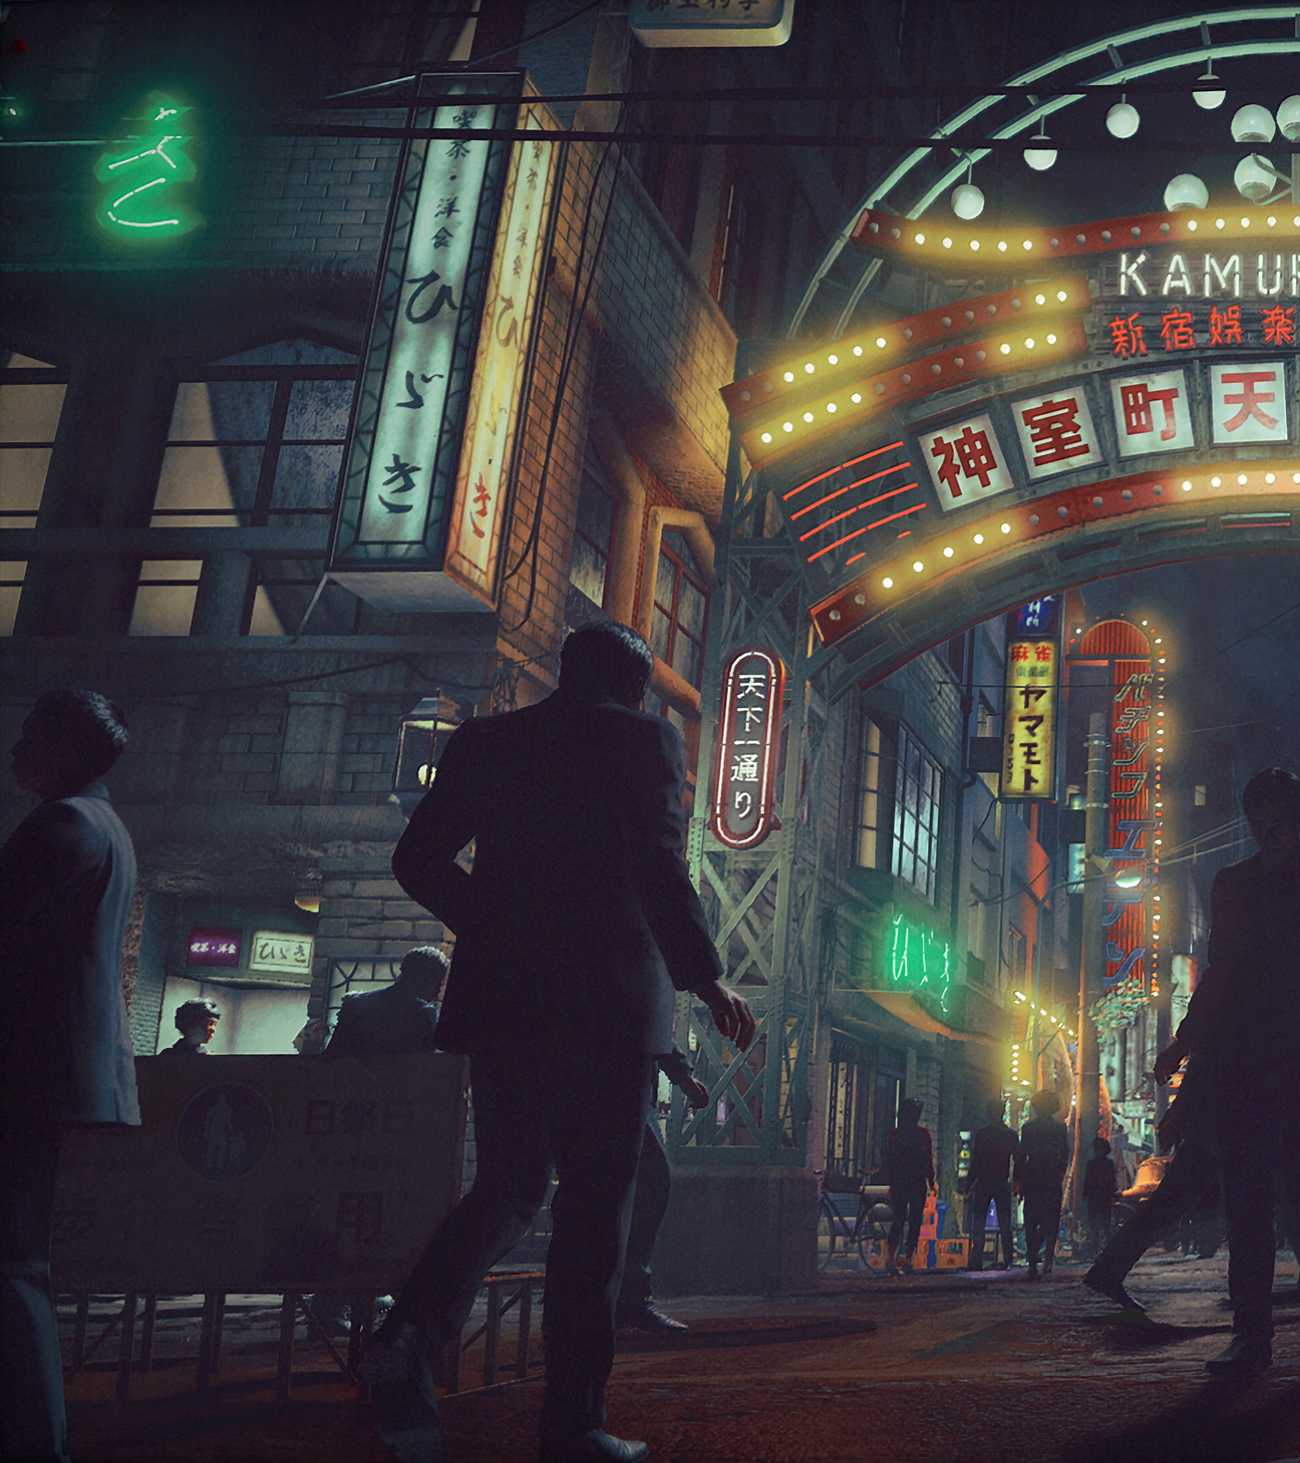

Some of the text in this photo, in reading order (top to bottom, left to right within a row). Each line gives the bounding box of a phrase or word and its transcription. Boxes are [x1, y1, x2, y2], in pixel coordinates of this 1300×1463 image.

[730, 674, 766, 818] 天下一通り
[1018, 685, 1047, 791] ヤマモト
